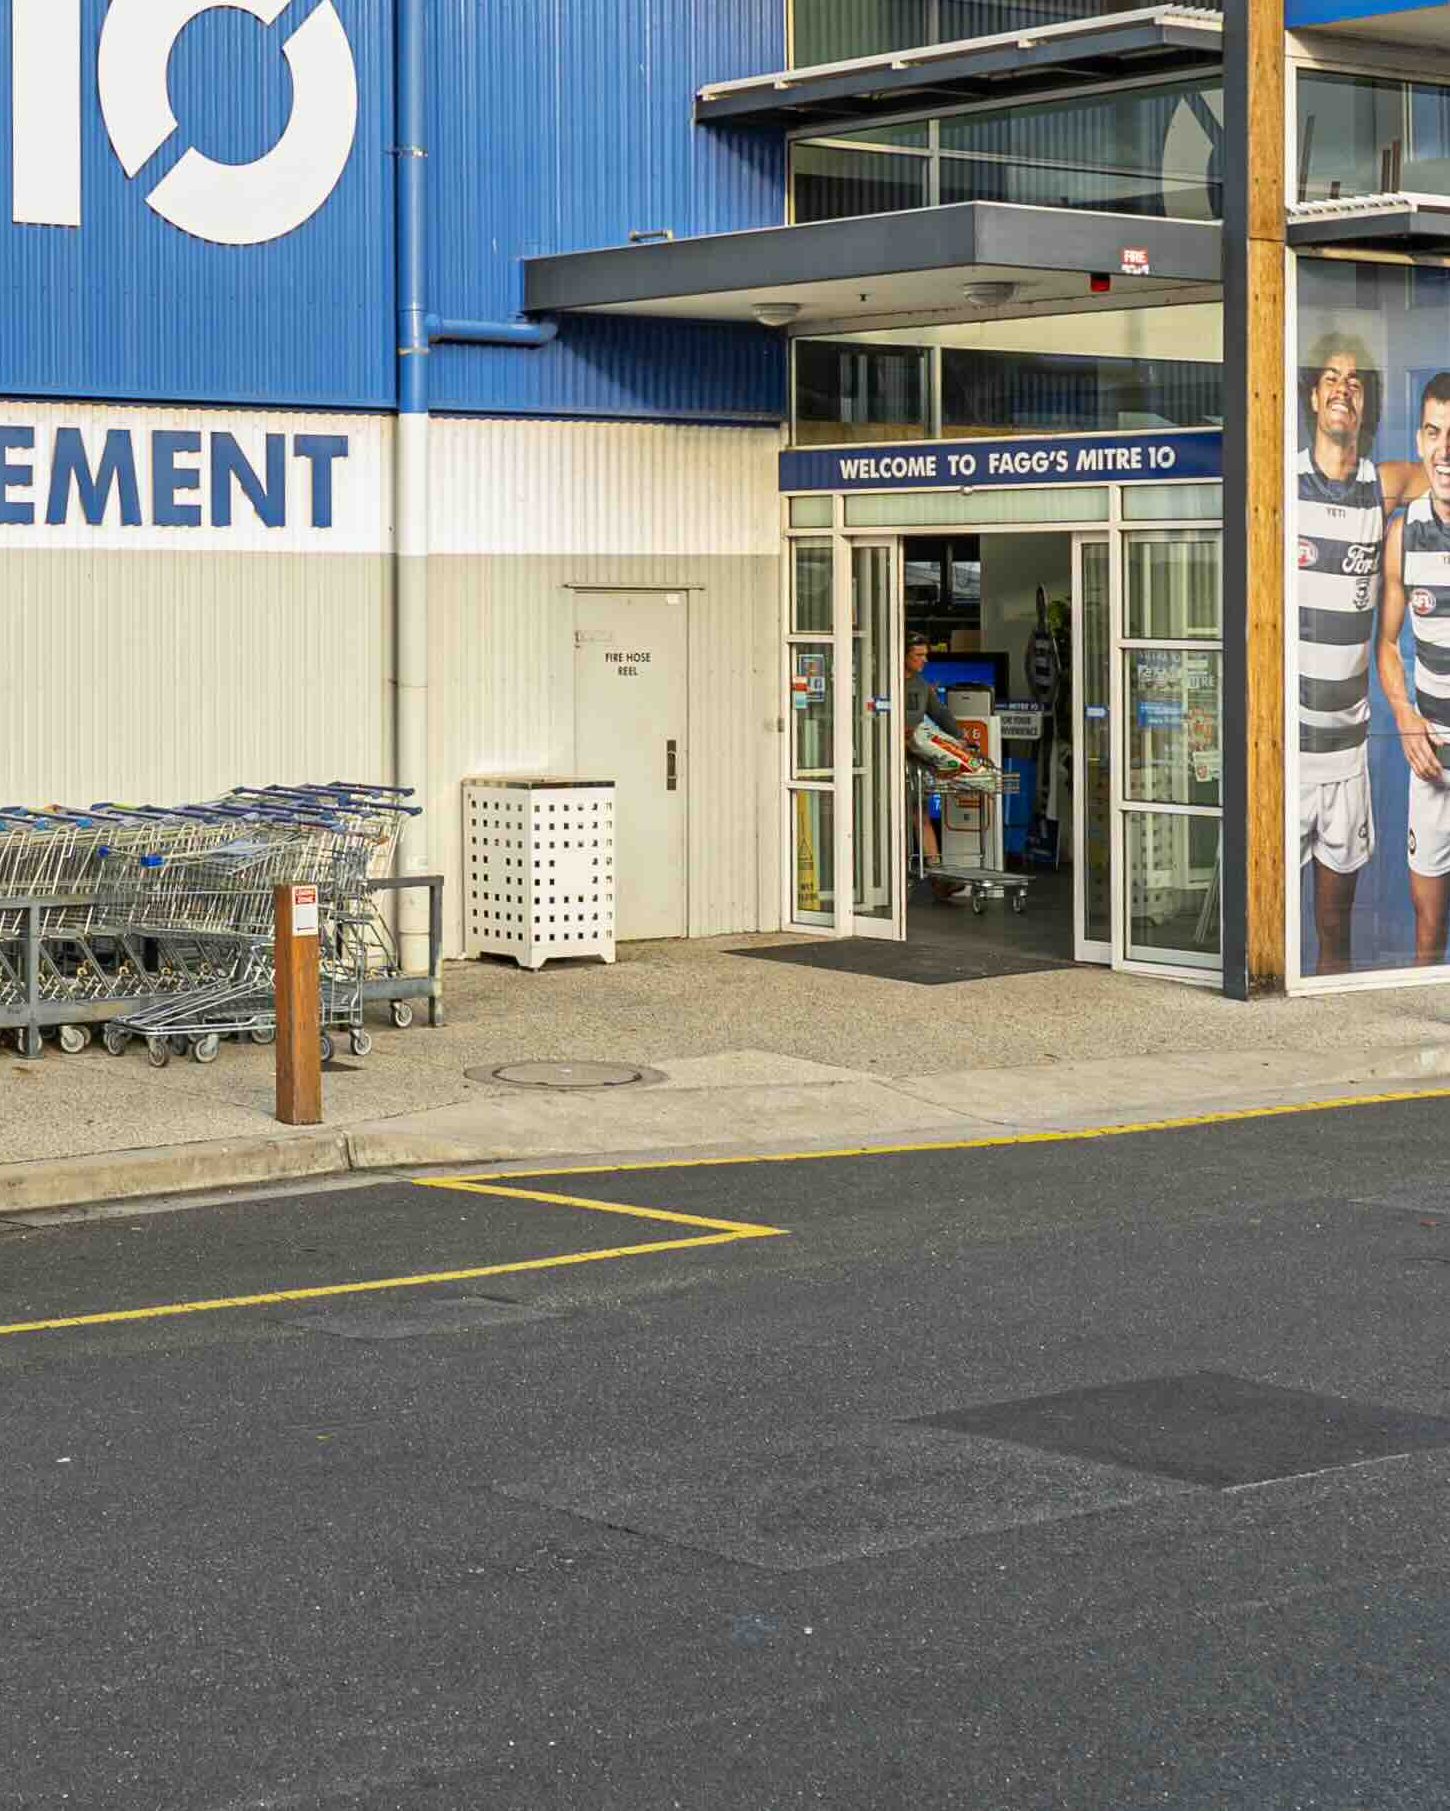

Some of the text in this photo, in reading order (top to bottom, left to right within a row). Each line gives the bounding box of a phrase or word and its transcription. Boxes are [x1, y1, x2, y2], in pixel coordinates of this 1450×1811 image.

[840, 446, 1175, 479] WELCOME TO FAGG'S MITRE 10
[605, 652, 651, 662] FIRE HOSE
[618, 666, 639, 676] REEL
